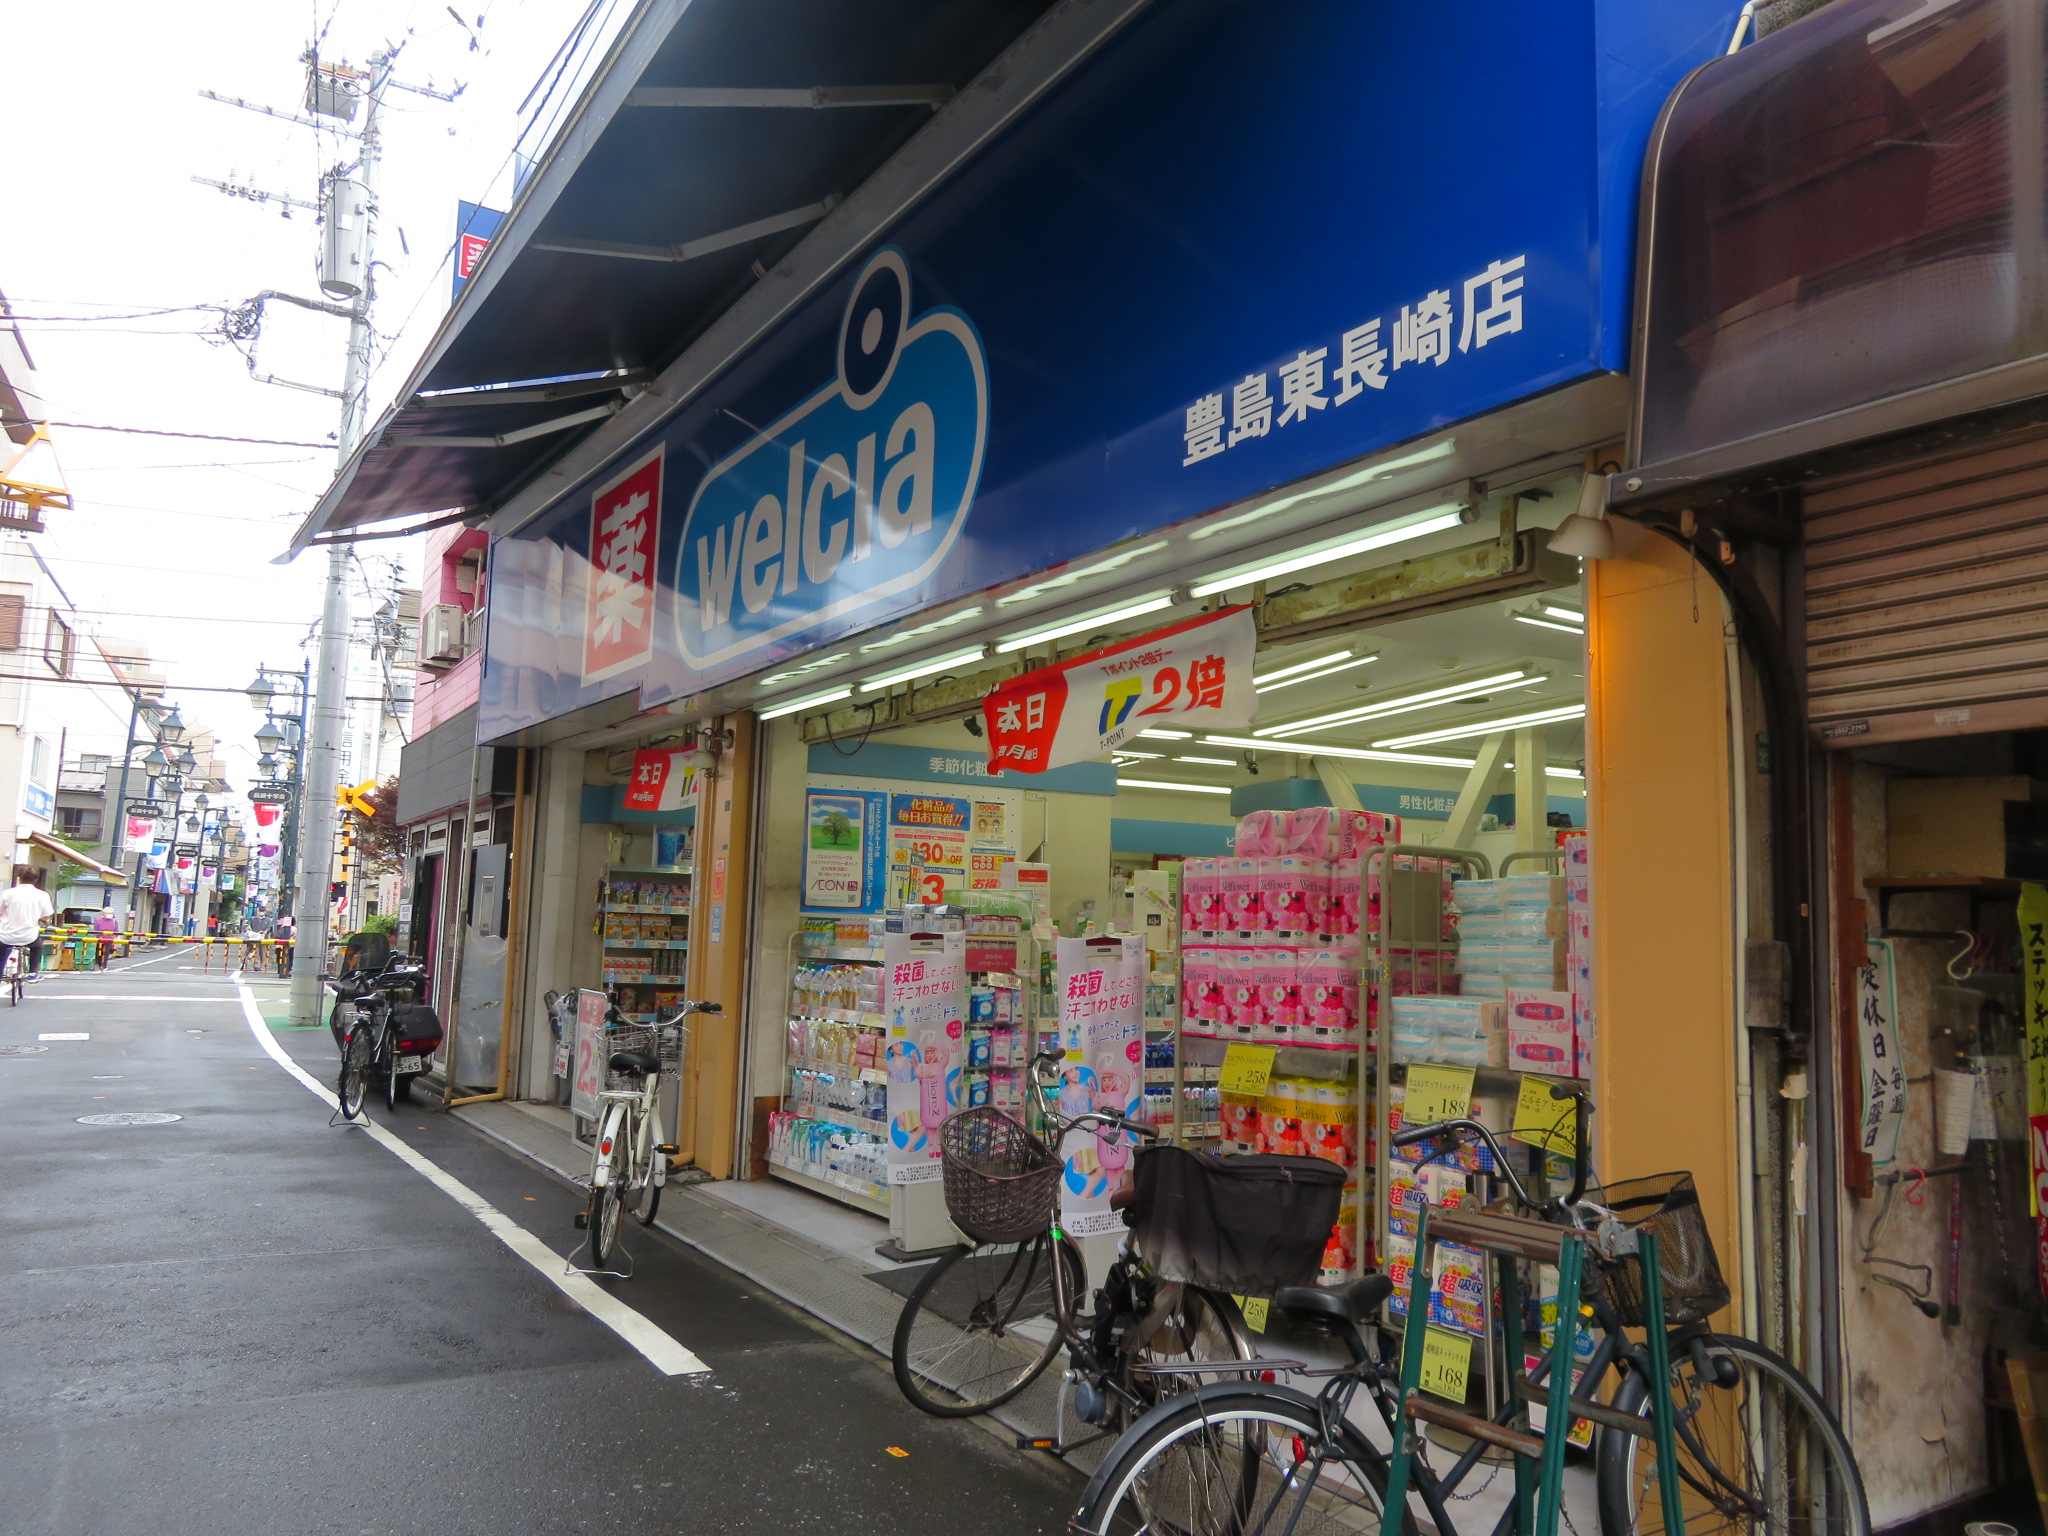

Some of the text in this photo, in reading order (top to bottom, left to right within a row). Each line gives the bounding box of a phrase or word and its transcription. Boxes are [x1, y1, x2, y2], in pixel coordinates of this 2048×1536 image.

[1182, 254, 1526, 468] 豊島東長崎店
[697, 401, 936, 633] welcia
[594, 491, 650, 650] 薬
[1136, 654, 1226, 718] 2倍
[996, 692, 1047, 734] 本日
[1100, 727, 1126, 751] T-POINT
[637, 762, 663, 786] 本日
[910, 798, 955, 812] 化粧品が
[1399, 795, 1457, 812] 男性化粧品
[874, 803, 882, 857] ウエルシアグループは
[1259, 876, 1292, 891] Welflower
[1859, 961, 1888, 1060] 定休日
[1245, 1069, 1267, 1085] 258
[1520, 1094, 1549, 1109] エルモア
[1888, 1065, 1905, 1115] 毎週
[1441, 1098, 1466, 1117] 188
[1863, 1067, 1888, 1150] 金曜日
[1247, 1301, 1266, 1320] 258
[1438, 1364, 1463, 1388] 168
